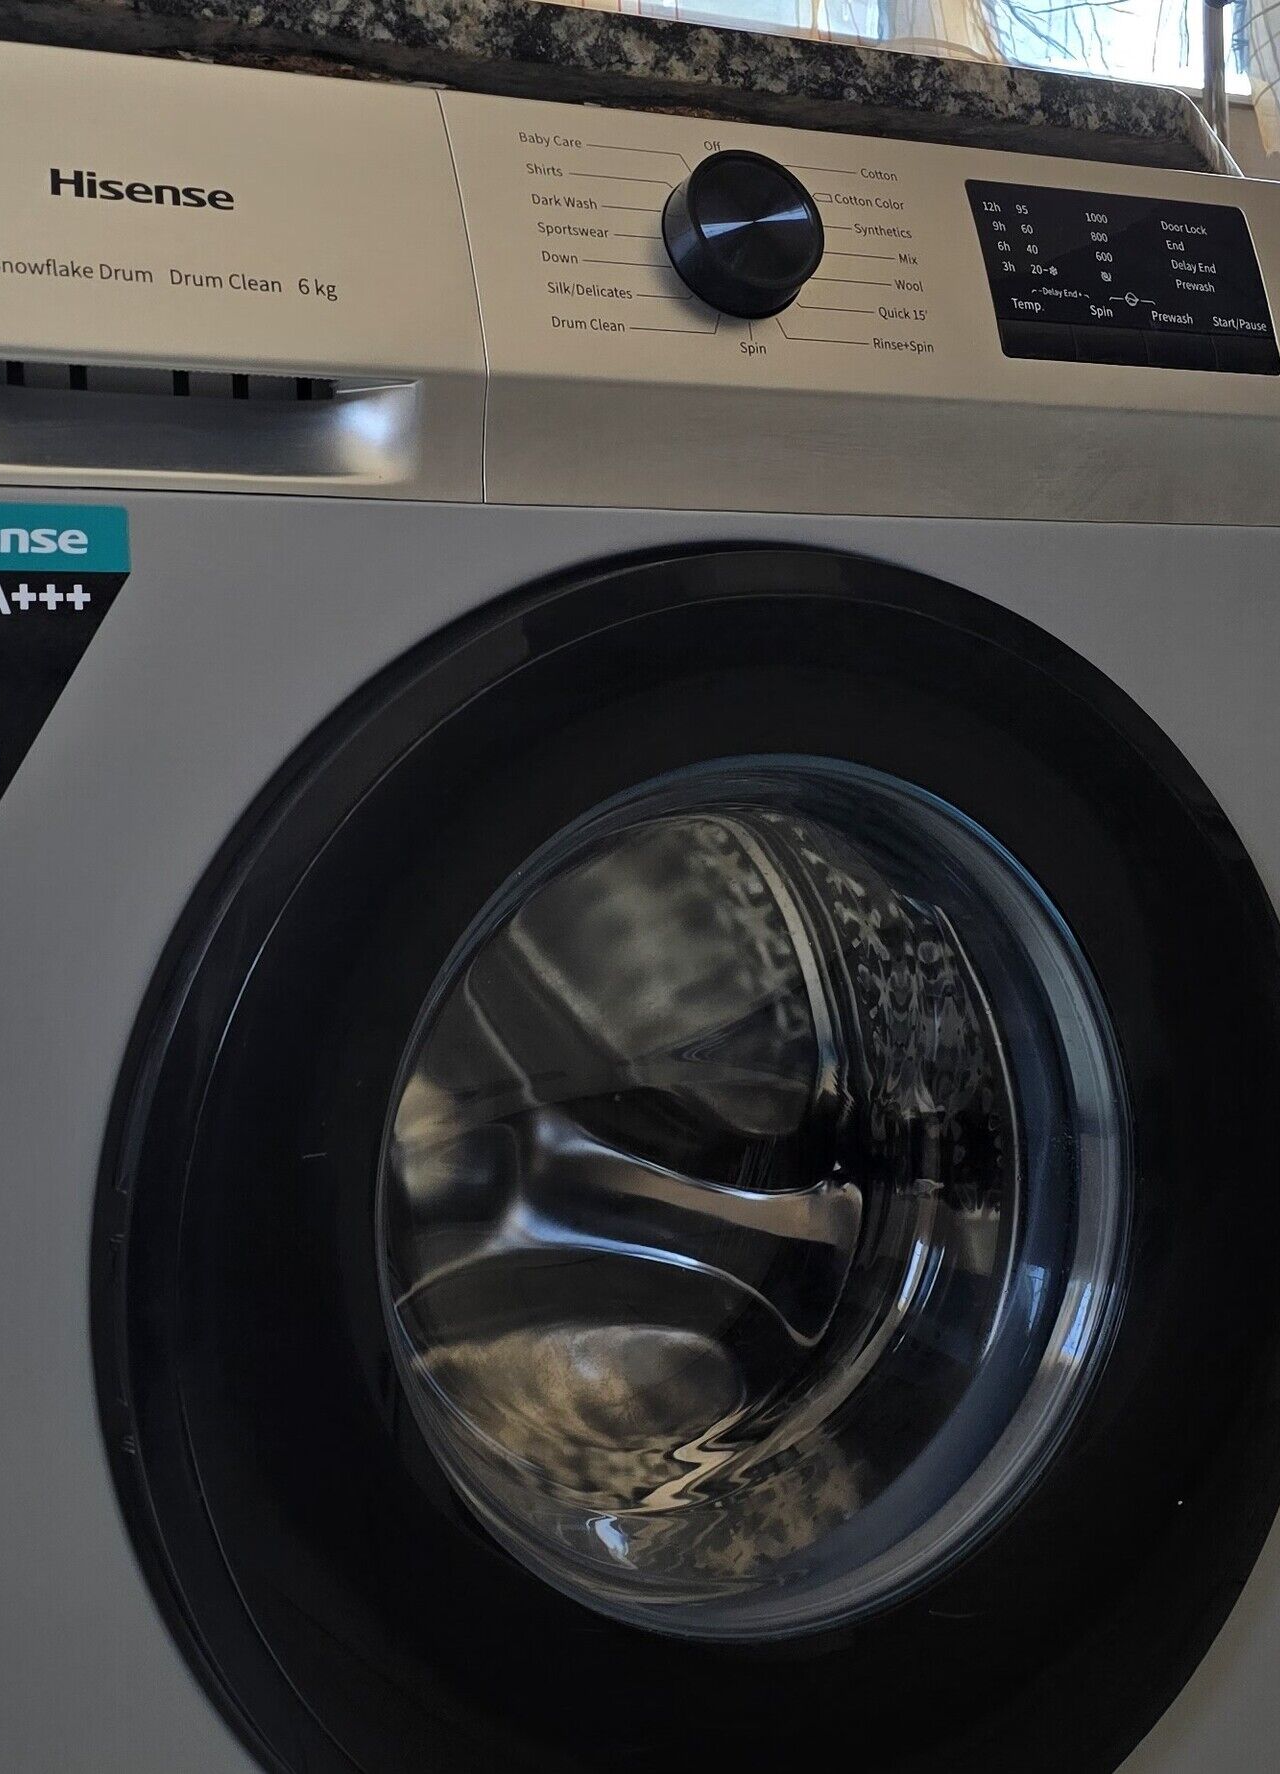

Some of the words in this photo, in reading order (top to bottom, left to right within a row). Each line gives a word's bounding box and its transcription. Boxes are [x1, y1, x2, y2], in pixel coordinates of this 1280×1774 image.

[518, 131, 550, 148] Baby
[553, 135, 582, 149] Care
[703, 140, 721, 152] Off
[525, 162, 564, 177] Shirts
[860, 168, 898, 182] Cotton
[49, 167, 235, 211] Hisense
[531, 193, 562, 207] Dark
[562, 196, 598, 210] Wash
[834, 193, 873, 208] Cotton
[874, 197, 905, 211] Color
[982, 201, 1002, 212] 12h
[1015, 204, 1029, 215] 95
[1085, 212, 1108, 224] 1000
[537, 221, 609, 238] Sportswear
[853, 223, 913, 239] Synthetics
[992, 220, 1007, 232] 9h
[1020, 223, 1034, 235] 60
[1160, 220, 1184, 233] Door
[1184, 223, 1208, 236] Lock
[1090, 231, 1108, 243] 800
[997, 240, 1011, 252] 6h
[1026, 244, 1039, 255] 40
[1165, 239, 1185, 252] End
[541, 250, 579, 265] Down
[898, 253, 919, 266] Mix
[1095, 251, 1113, 263] 600
[1001, 260, 1016, 272] 3h
[1170, 258, 1197, 274] Delay
[1197, 262, 1217, 274] End
[99, 263, 154, 283] Drum
[169, 268, 223, 289] Drum
[228, 273, 282, 293] Clean
[298, 277, 310, 295] 6
[314, 278, 338, 302] kg
[894, 279, 924, 293] Wool
[1175, 278, 1216, 293] Prewash
[547, 281, 633, 300] Silk/Delicates
[878, 306, 911, 321] Quick
[1010, 297, 1045, 314] Temp.
[1089, 304, 1114, 319] Spin
[1151, 310, 1194, 325] Prewash
[1212, 315, 1267, 332] Start/Pause
[551, 315, 587, 330] Drum
[589, 318, 626, 332] Clean
[739, 341, 767, 357] Spin
[872, 337, 935, 355] Rinse+Spin
